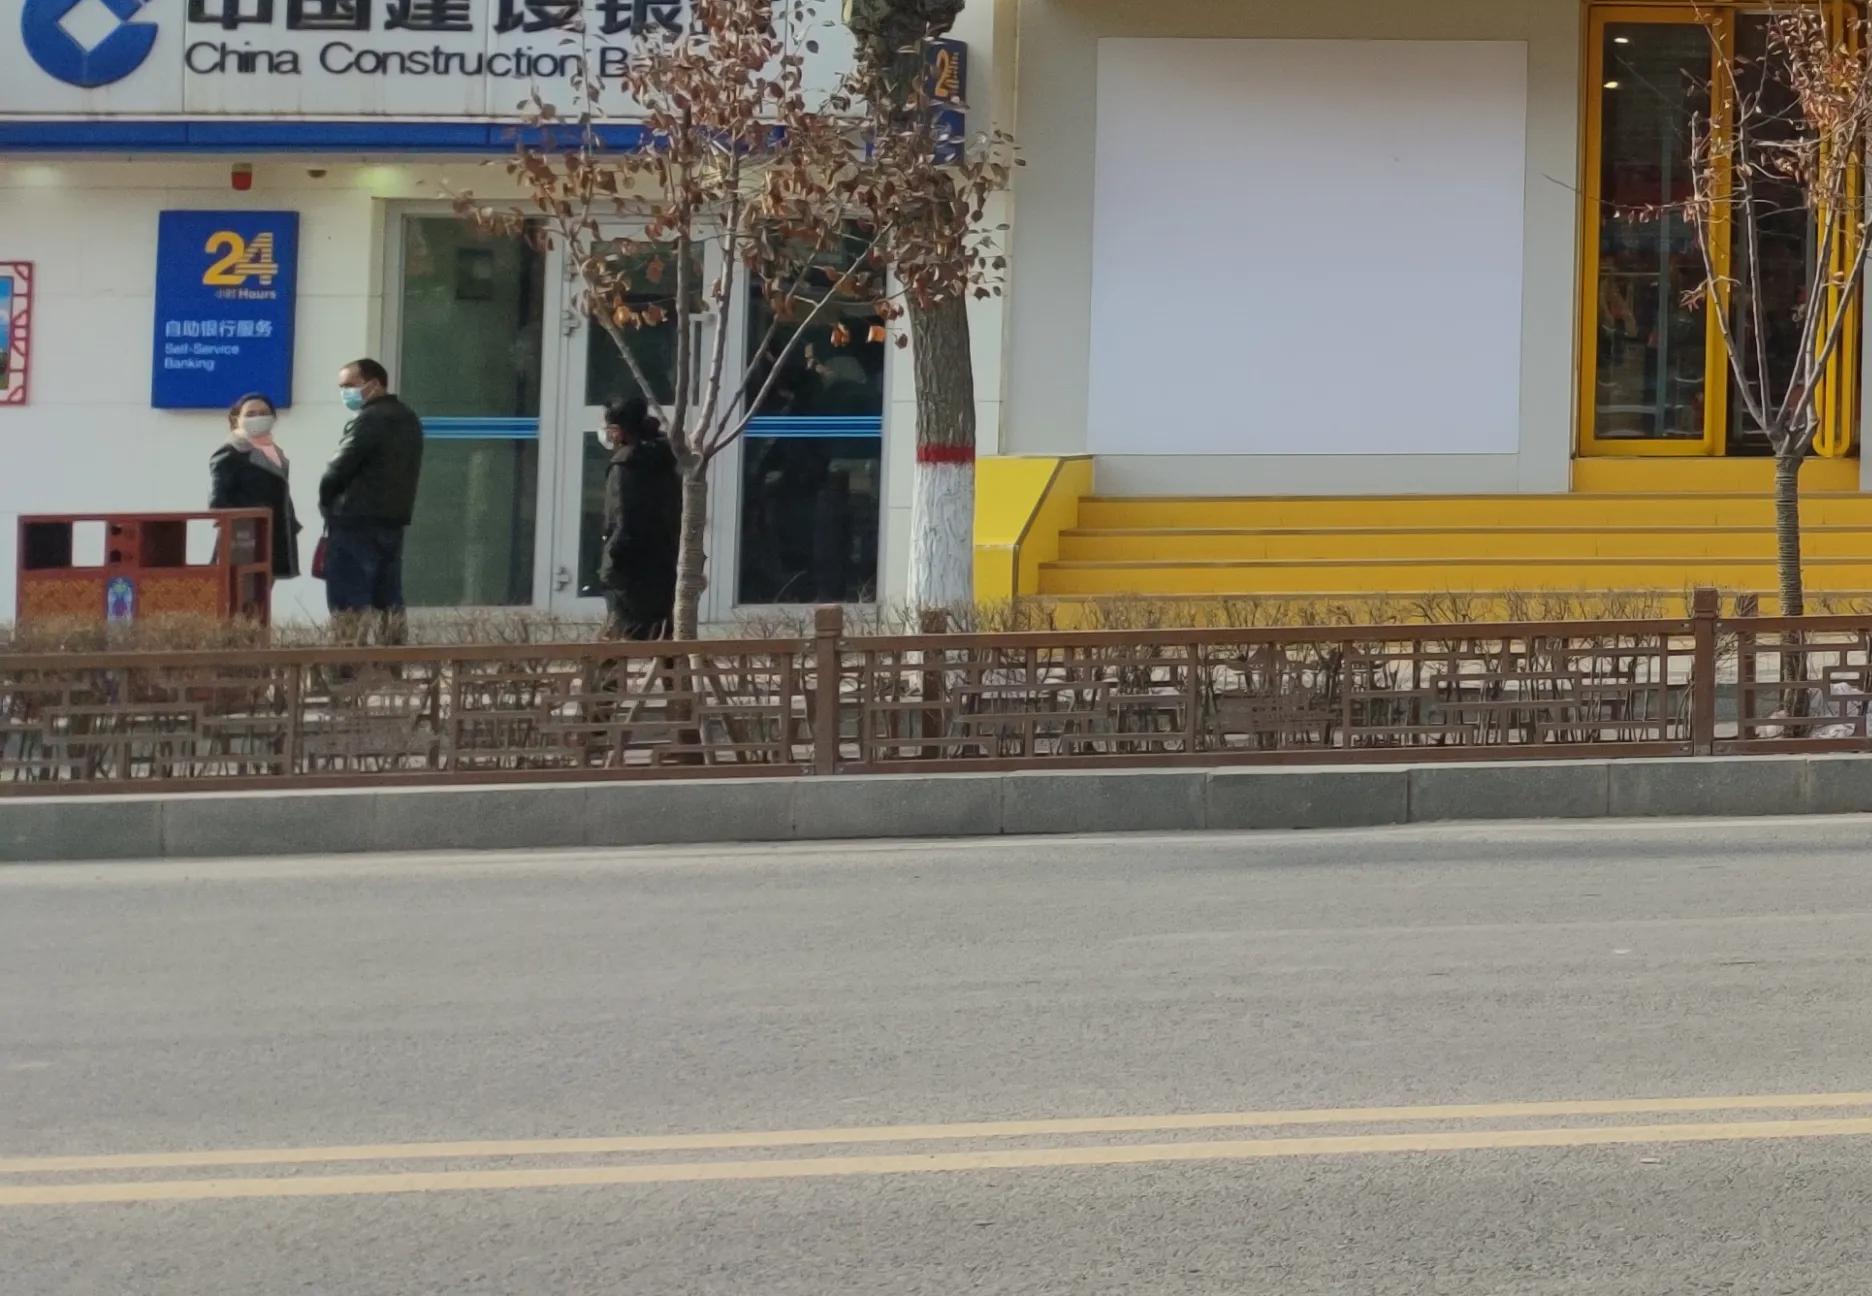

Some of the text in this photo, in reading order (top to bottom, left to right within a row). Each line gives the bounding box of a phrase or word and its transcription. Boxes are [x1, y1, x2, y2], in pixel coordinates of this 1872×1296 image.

[184, 40, 301, 75] China
[318, 40, 584, 78] Construction
[202, 230, 279, 286] 24
[237, 287, 277, 300] Hours
[165, 319, 273, 338] 自助银行服务
[164, 342, 240, 355] Self-Service
[164, 357, 215, 372] Banking
